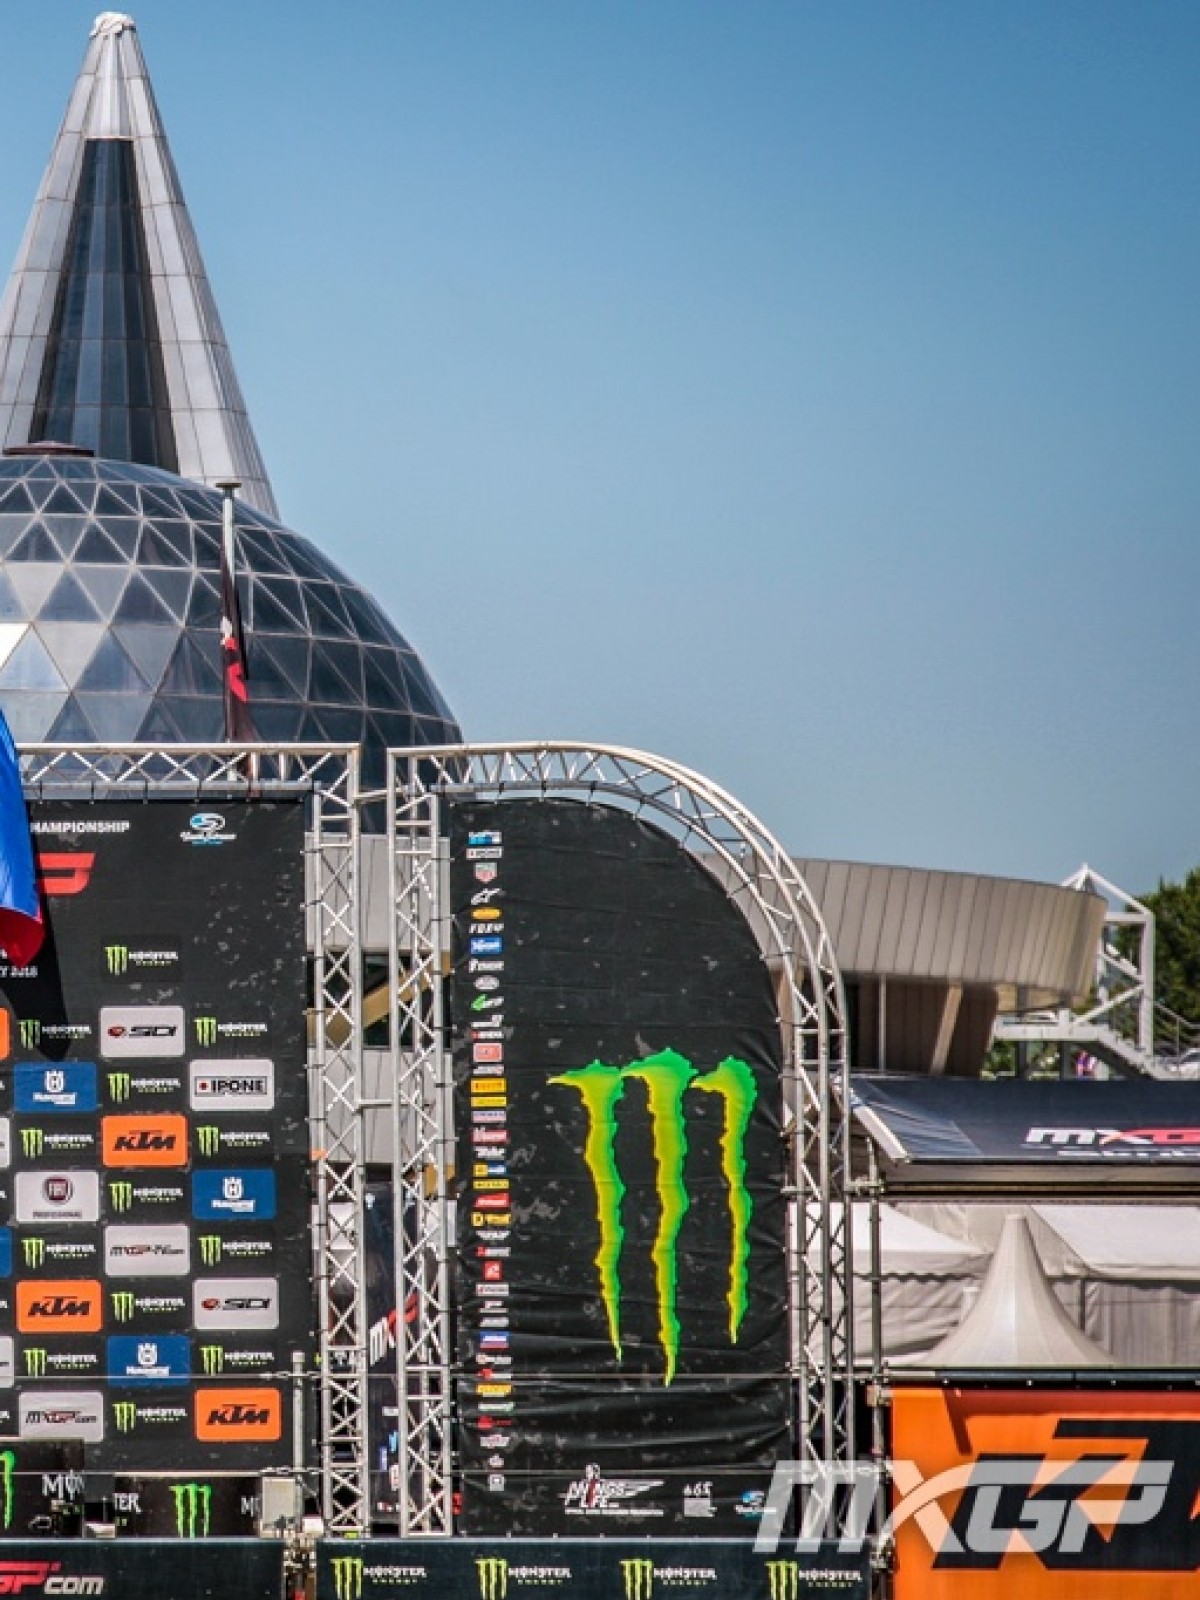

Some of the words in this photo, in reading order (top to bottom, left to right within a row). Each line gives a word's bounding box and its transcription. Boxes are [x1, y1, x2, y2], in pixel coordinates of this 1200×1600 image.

[112, 1130, 176, 1151] KTM
[28, 1296, 91, 1317] KTM
[206, 1404, 270, 1425] KTM
